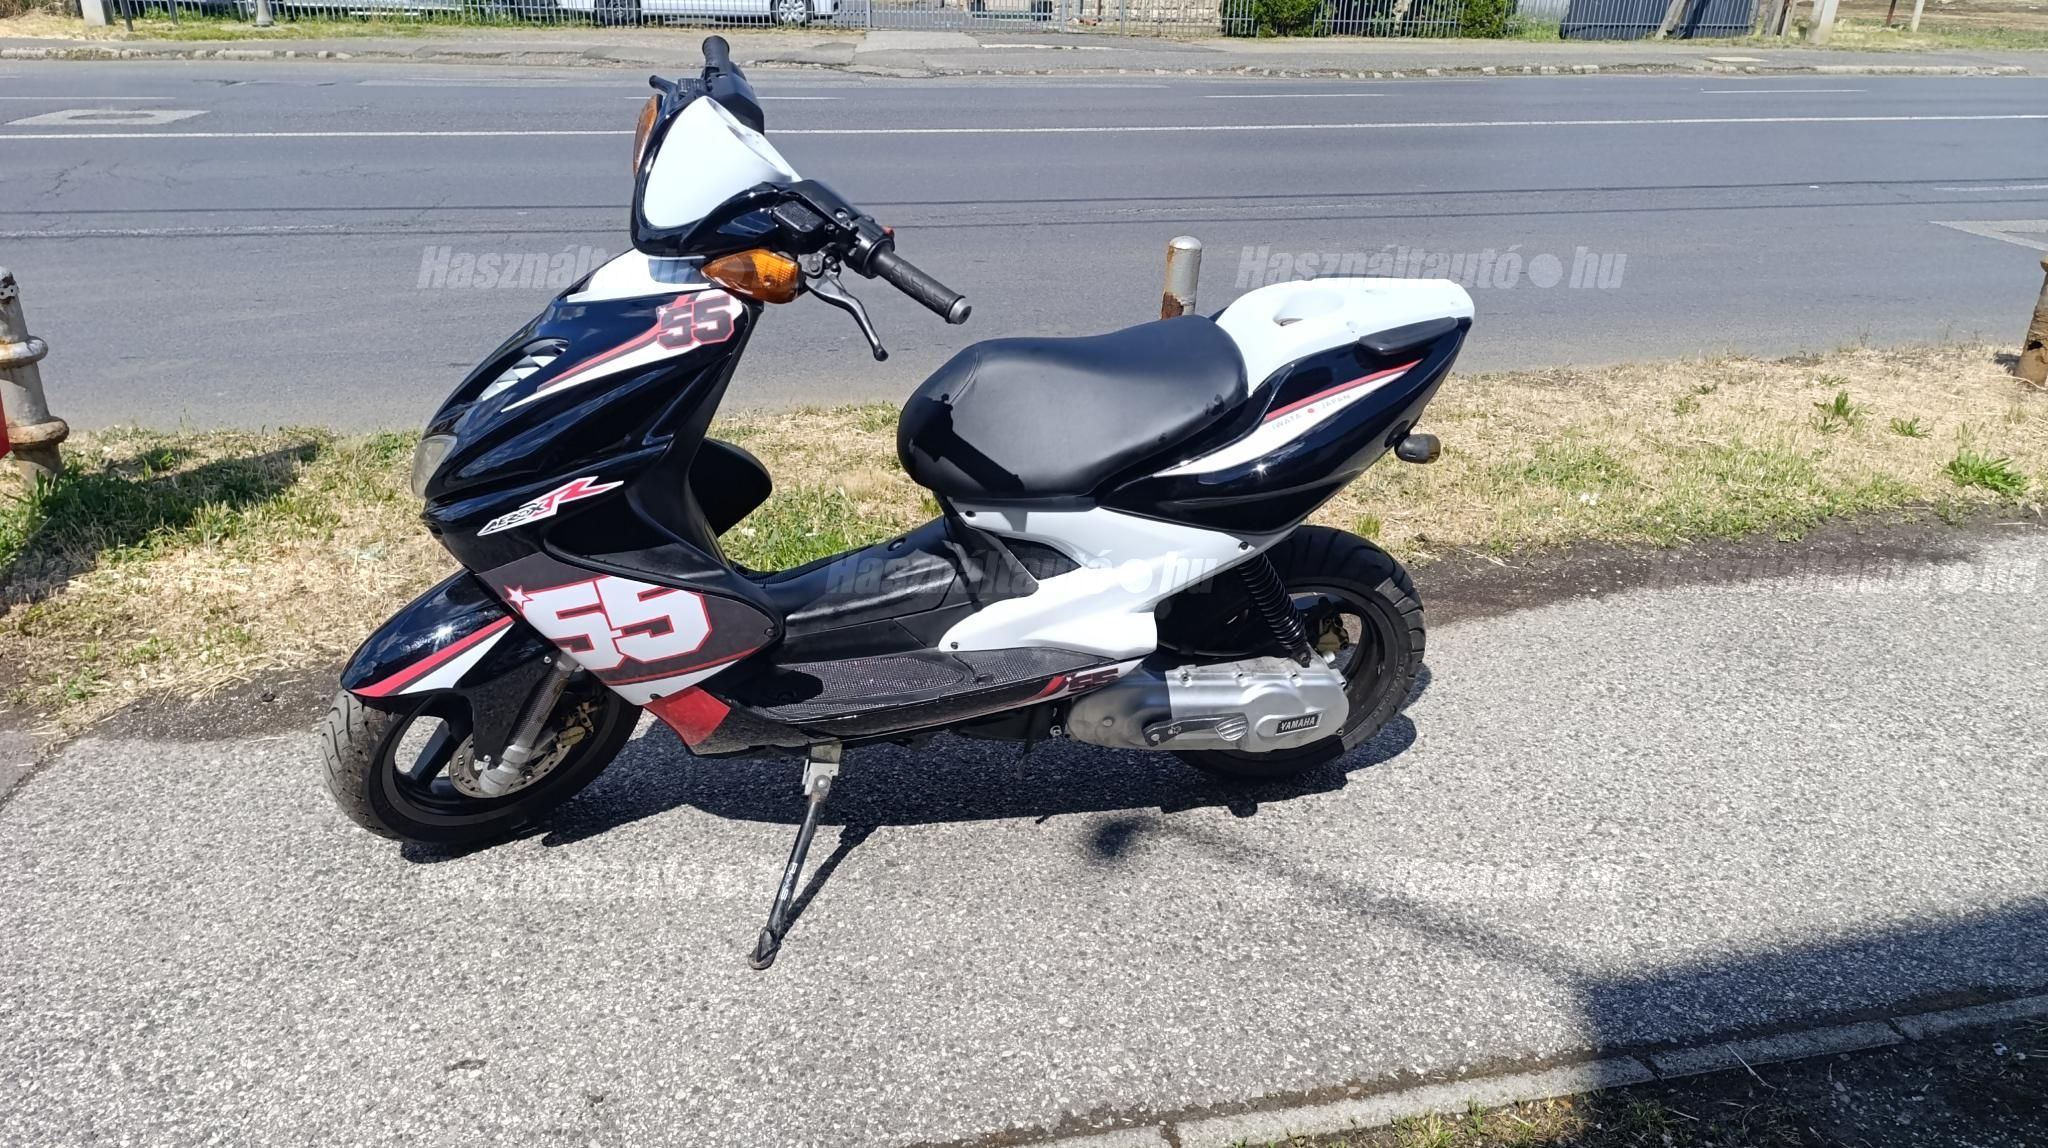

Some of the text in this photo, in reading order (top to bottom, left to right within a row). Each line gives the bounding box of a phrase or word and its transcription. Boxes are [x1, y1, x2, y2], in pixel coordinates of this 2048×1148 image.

[657, 294, 735, 350] 55
[517, 575, 713, 671] 55
[1280, 713, 1317, 731] YAMAHA
